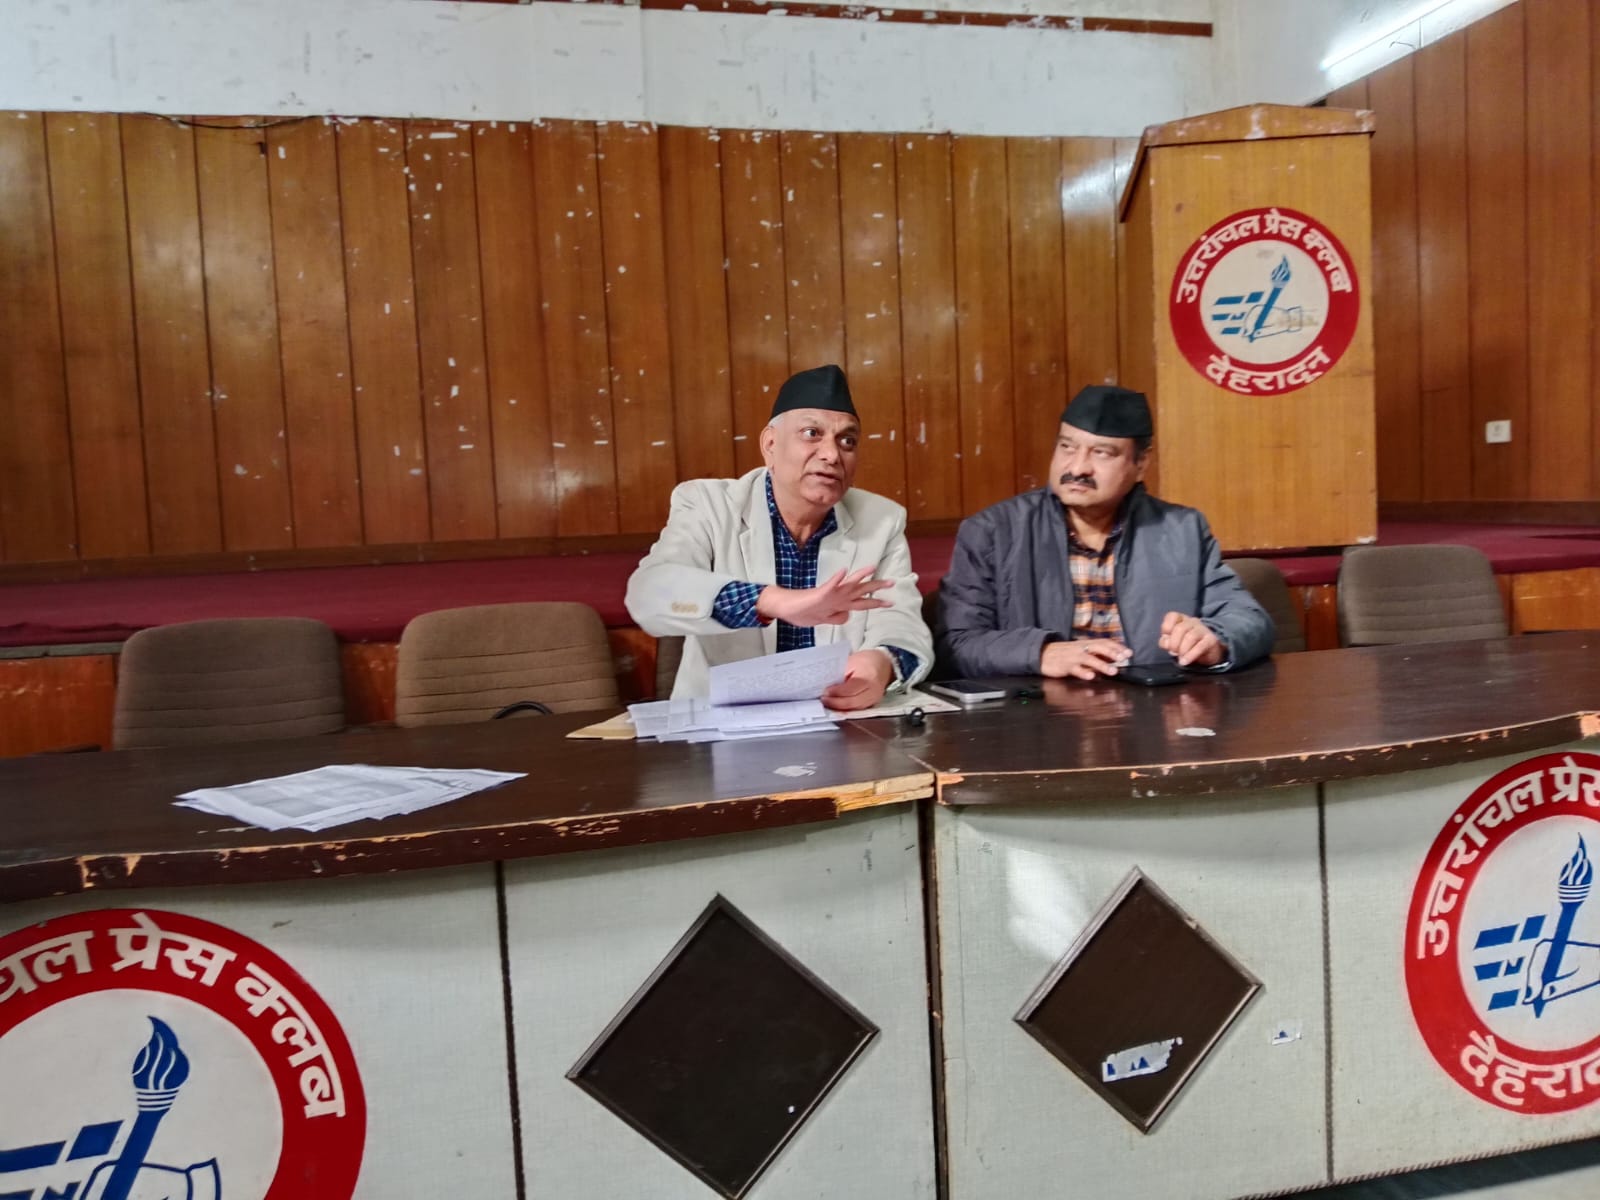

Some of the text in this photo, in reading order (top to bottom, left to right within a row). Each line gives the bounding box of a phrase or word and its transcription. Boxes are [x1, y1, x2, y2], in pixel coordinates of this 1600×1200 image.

[1263, 207, 1308, 241] प्रेस
[1301, 228, 1353, 294] क्लब
[1205, 345, 1331, 393] देहरादून
[1416, 769, 1545, 960] उत्तरांचल
[108, 911, 238, 987] प्रेस
[234, 961, 346, 1120] क्लब
